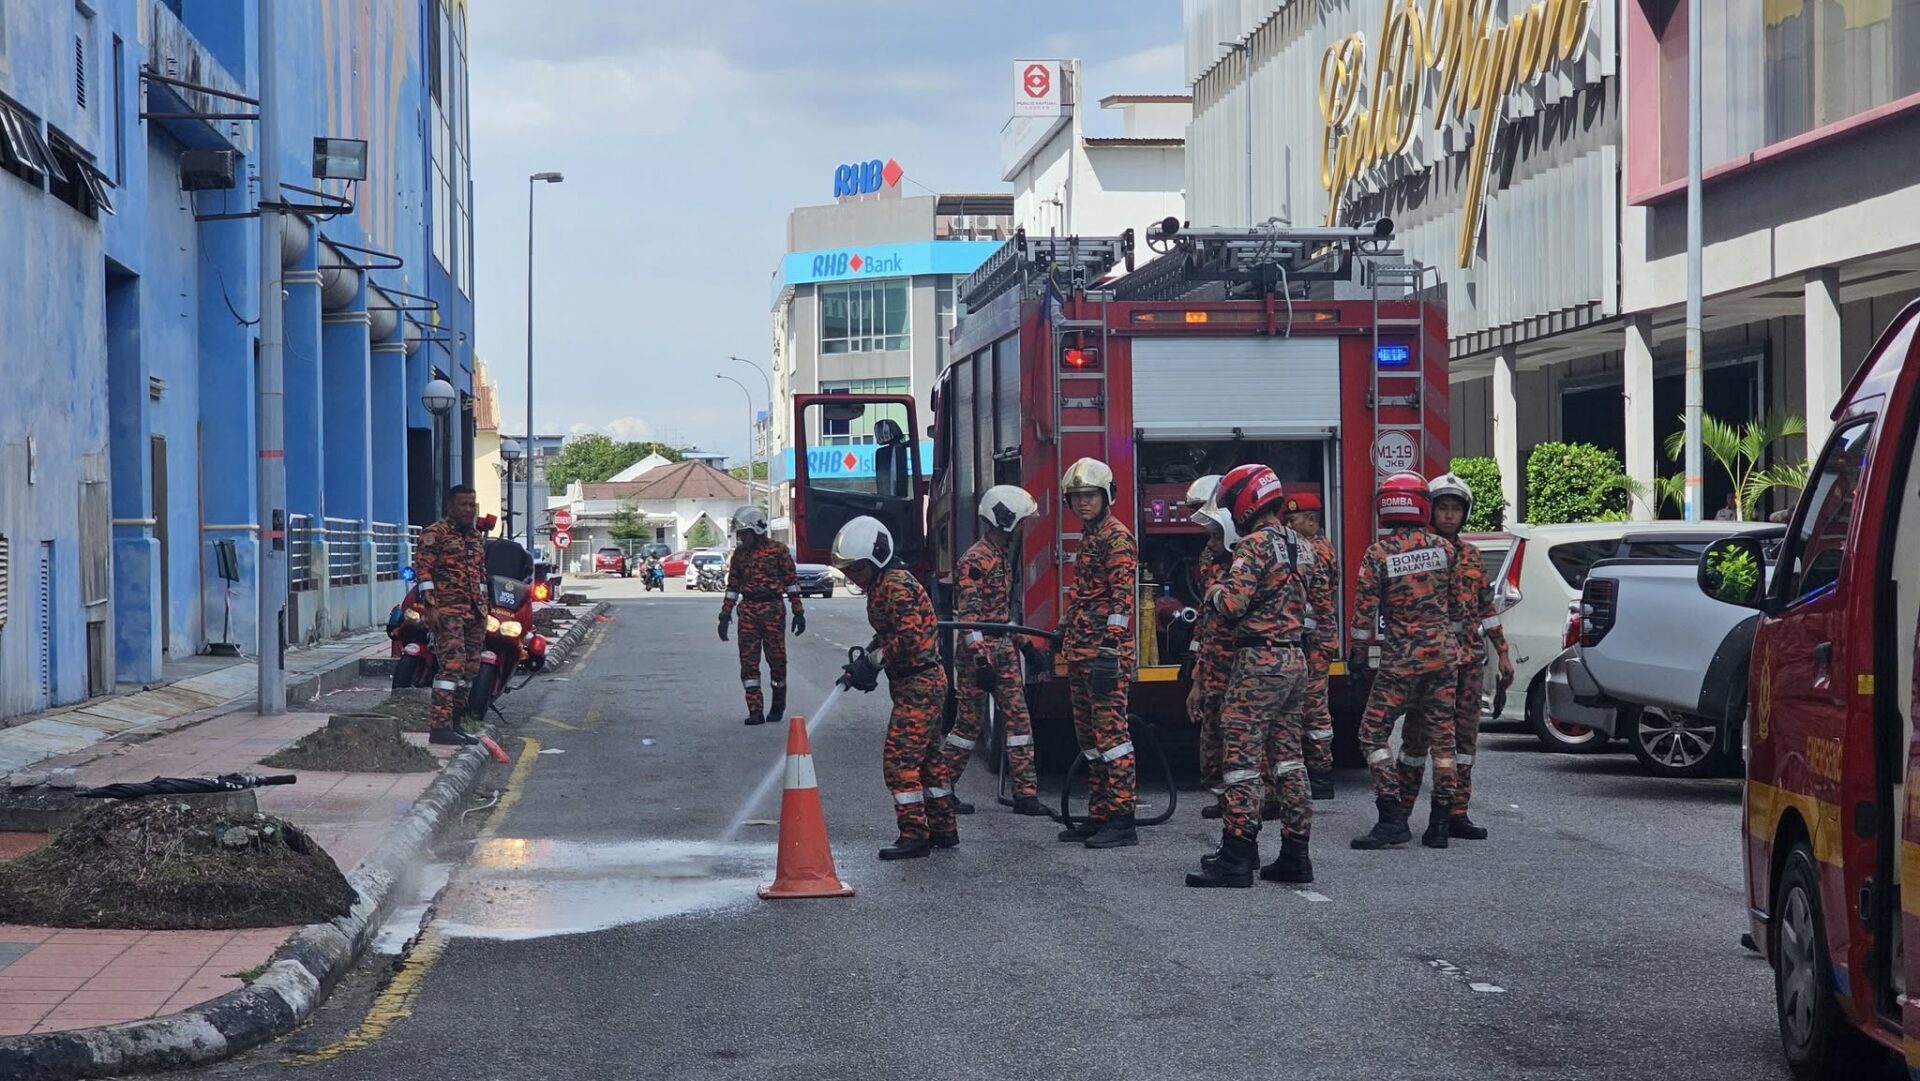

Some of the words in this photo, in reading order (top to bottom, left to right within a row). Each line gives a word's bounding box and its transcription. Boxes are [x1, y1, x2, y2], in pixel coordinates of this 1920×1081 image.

[833, 158, 883, 198] RHB
[812, 252, 848, 278] RHB
[865, 252, 903, 273] Bank
[1377, 445, 1412, 458] M1-19
[807, 449, 842, 474] RHB
[1384, 460, 1405, 468] JKB
[1381, 497, 1414, 506] BOMBA
[1392, 551, 1440, 567] BOMBA
[1393, 561, 1442, 575] MALAYSIA
